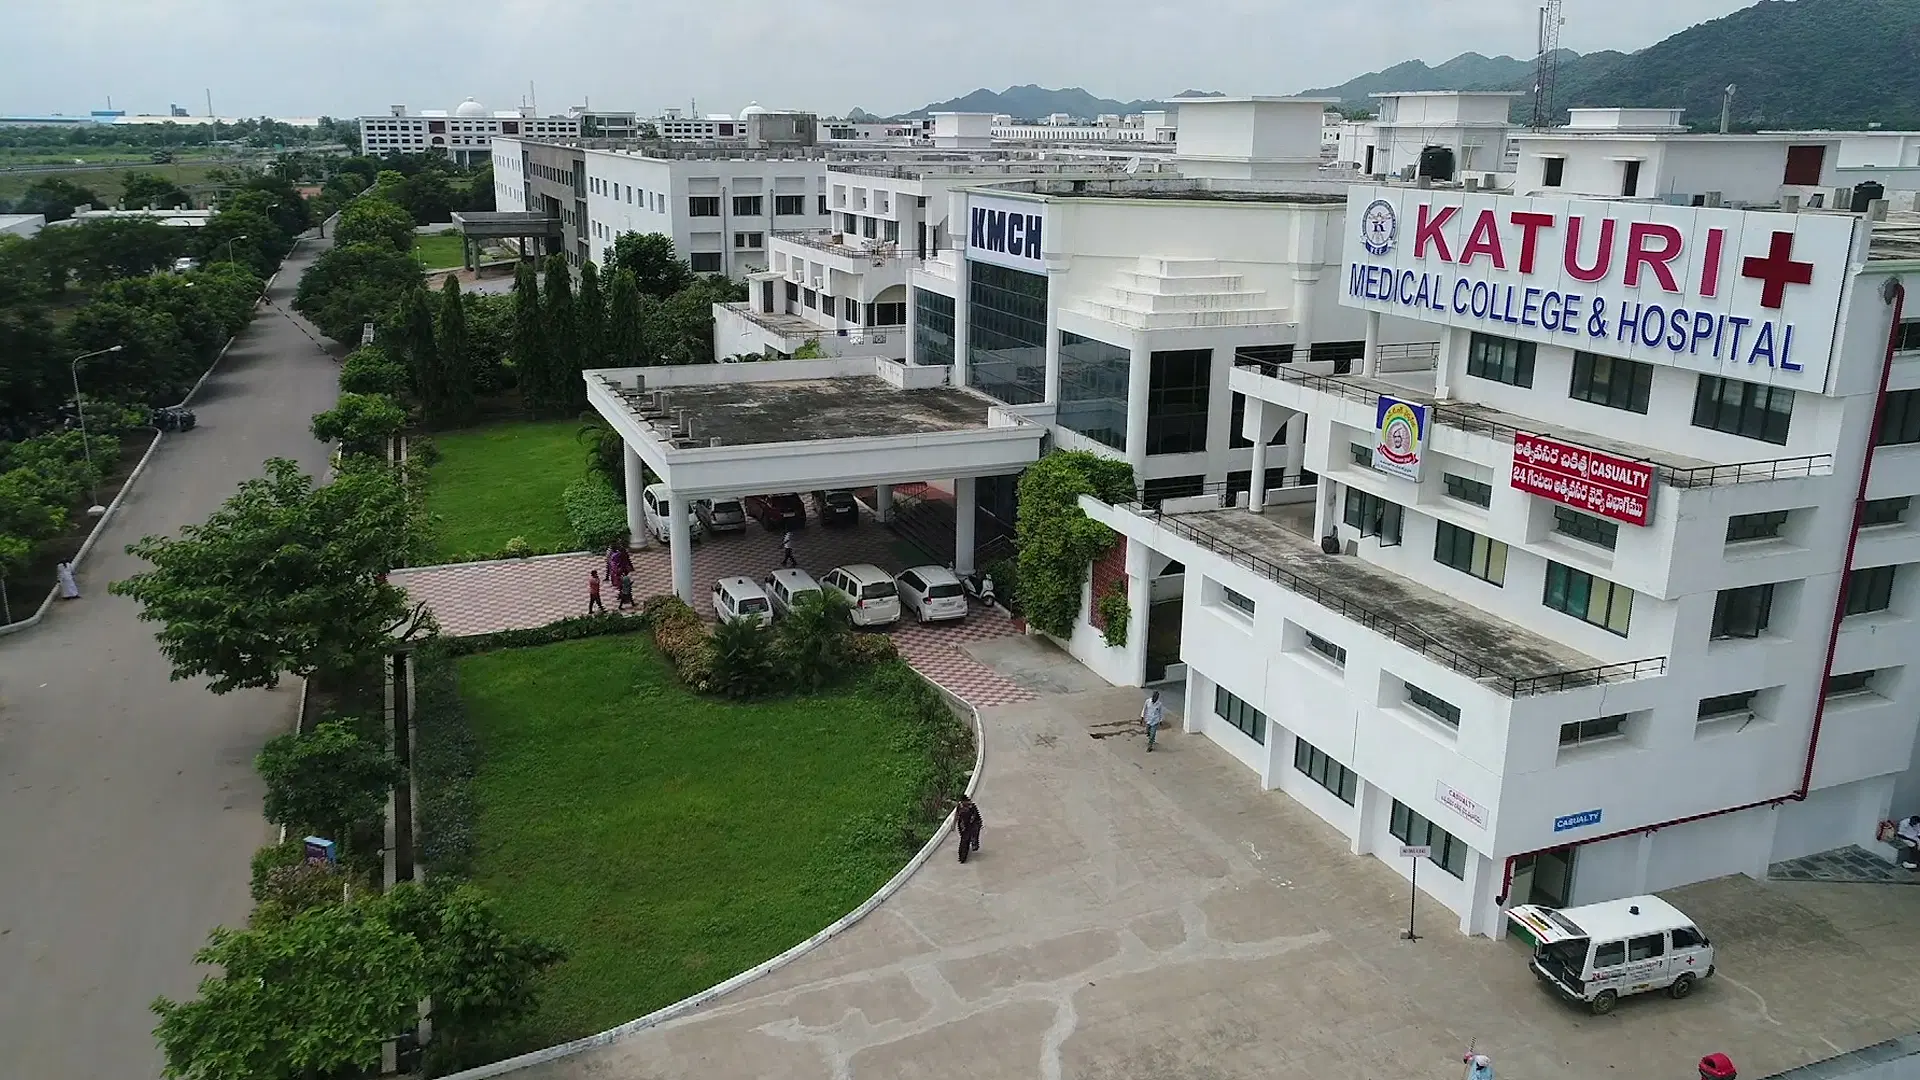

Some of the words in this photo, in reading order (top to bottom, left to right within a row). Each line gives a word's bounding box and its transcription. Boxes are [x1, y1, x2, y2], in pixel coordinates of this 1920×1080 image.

[971, 206, 1043, 260] KMCH
[1413, 203, 1726, 298] KATURI
[1348, 262, 1446, 312] MEDICAL
[1453, 278, 1583, 334] COLLEGE
[1587, 297, 1608, 338] &
[1617, 300, 1803, 371] HOSPITAL
[1513, 466, 1526, 483] 24
[1590, 460, 1649, 488] CASUALTY
[1448, 789, 1476, 810] CASUALTY
[1557, 812, 1600, 828] CASUALTY
